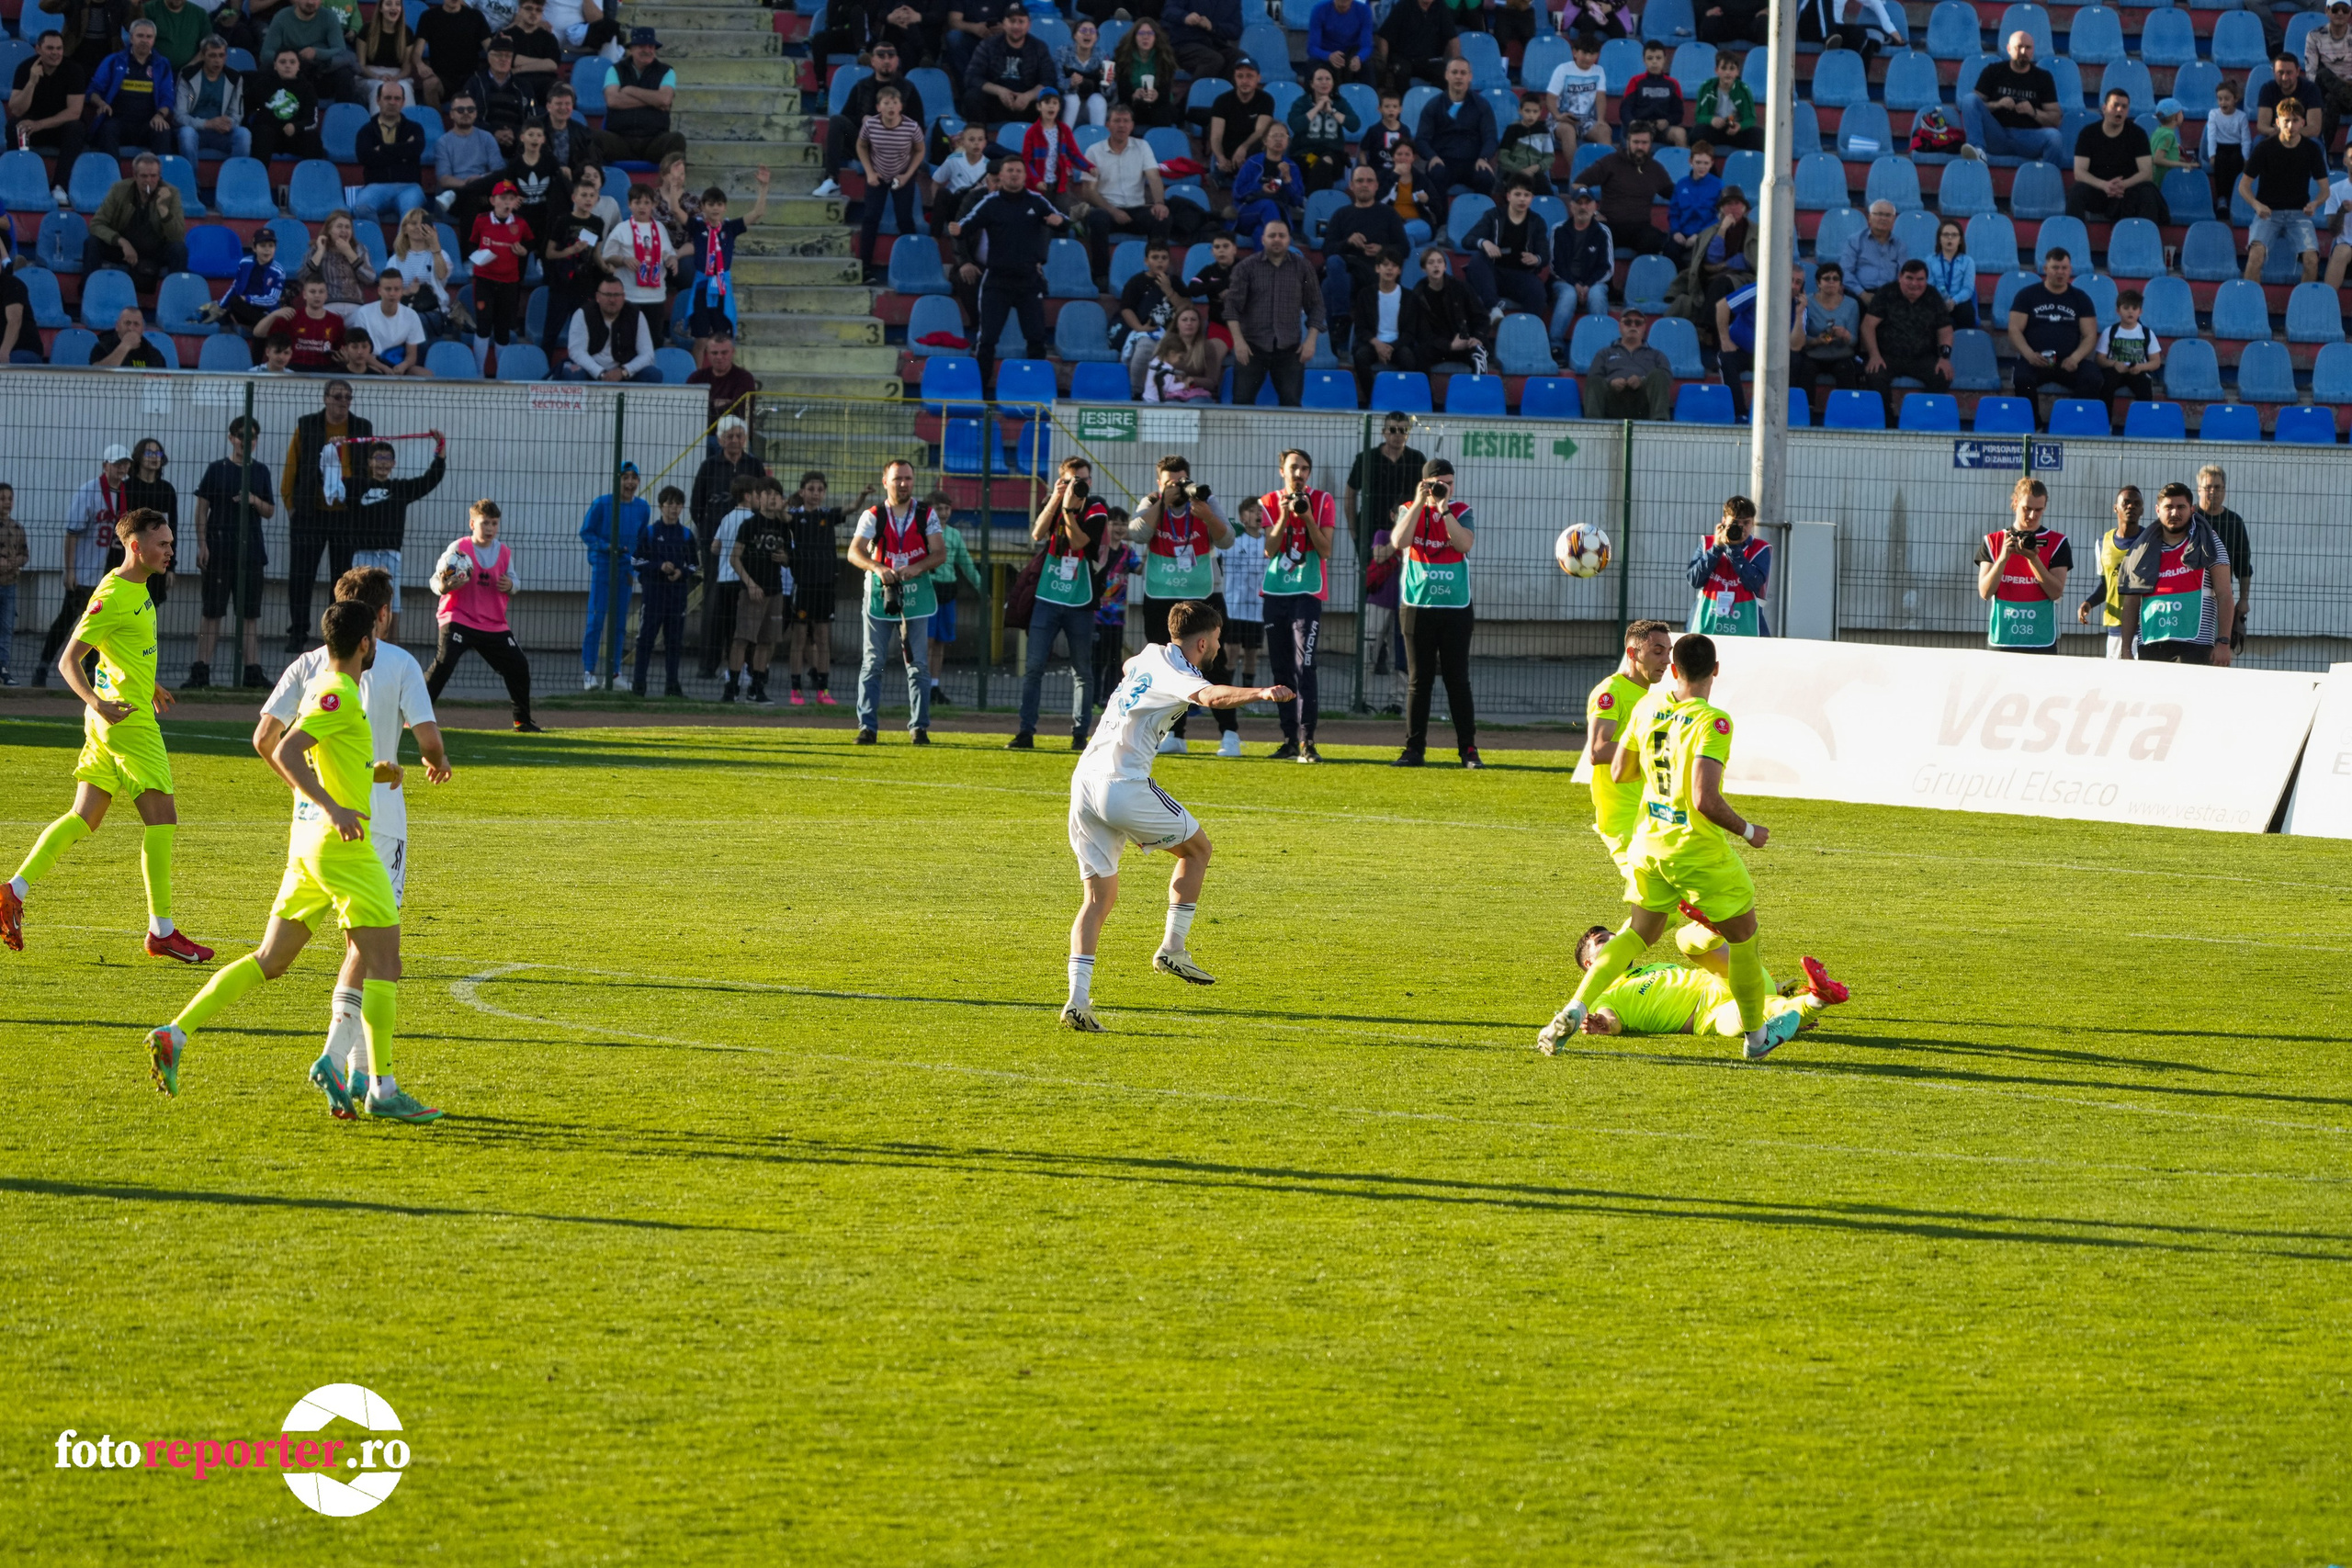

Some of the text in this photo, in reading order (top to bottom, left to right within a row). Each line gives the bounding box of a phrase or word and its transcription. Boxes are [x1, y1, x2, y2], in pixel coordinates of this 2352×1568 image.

[783, 94, 797, 112] 7
[803, 146, 818, 164] 6
[826, 202, 840, 221] 5
[2033, 303, 2076, 317] POLO CLUB
[865, 323, 880, 344] 3
[530, 385, 583, 395] PELUZA NORD
[885, 382, 899, 399] 2
[531, 400, 582, 409] SECTOR A
[1081, 412, 1133, 426] IESIRE
[1462, 431, 1535, 459] IESIRE
[1164, 578, 1187, 588] 492
[1423, 572, 1455, 583] FOTO
[1051, 580, 1072, 593] 039
[1430, 584, 1452, 595] 054
[2004, 609, 2037, 620] FOTO
[2159, 616, 2178, 627] 043
[1714, 623, 1736, 634] 058
[2011, 624, 2034, 635] 038
[452, 632, 463, 643] CS
[1304, 620, 1318, 667] GIVOVA
[1937, 671, 2184, 762] Vestra
[1912, 762, 2119, 807] Grupul Elsaco
[2127, 799, 2251, 825] www.vestra.ro
